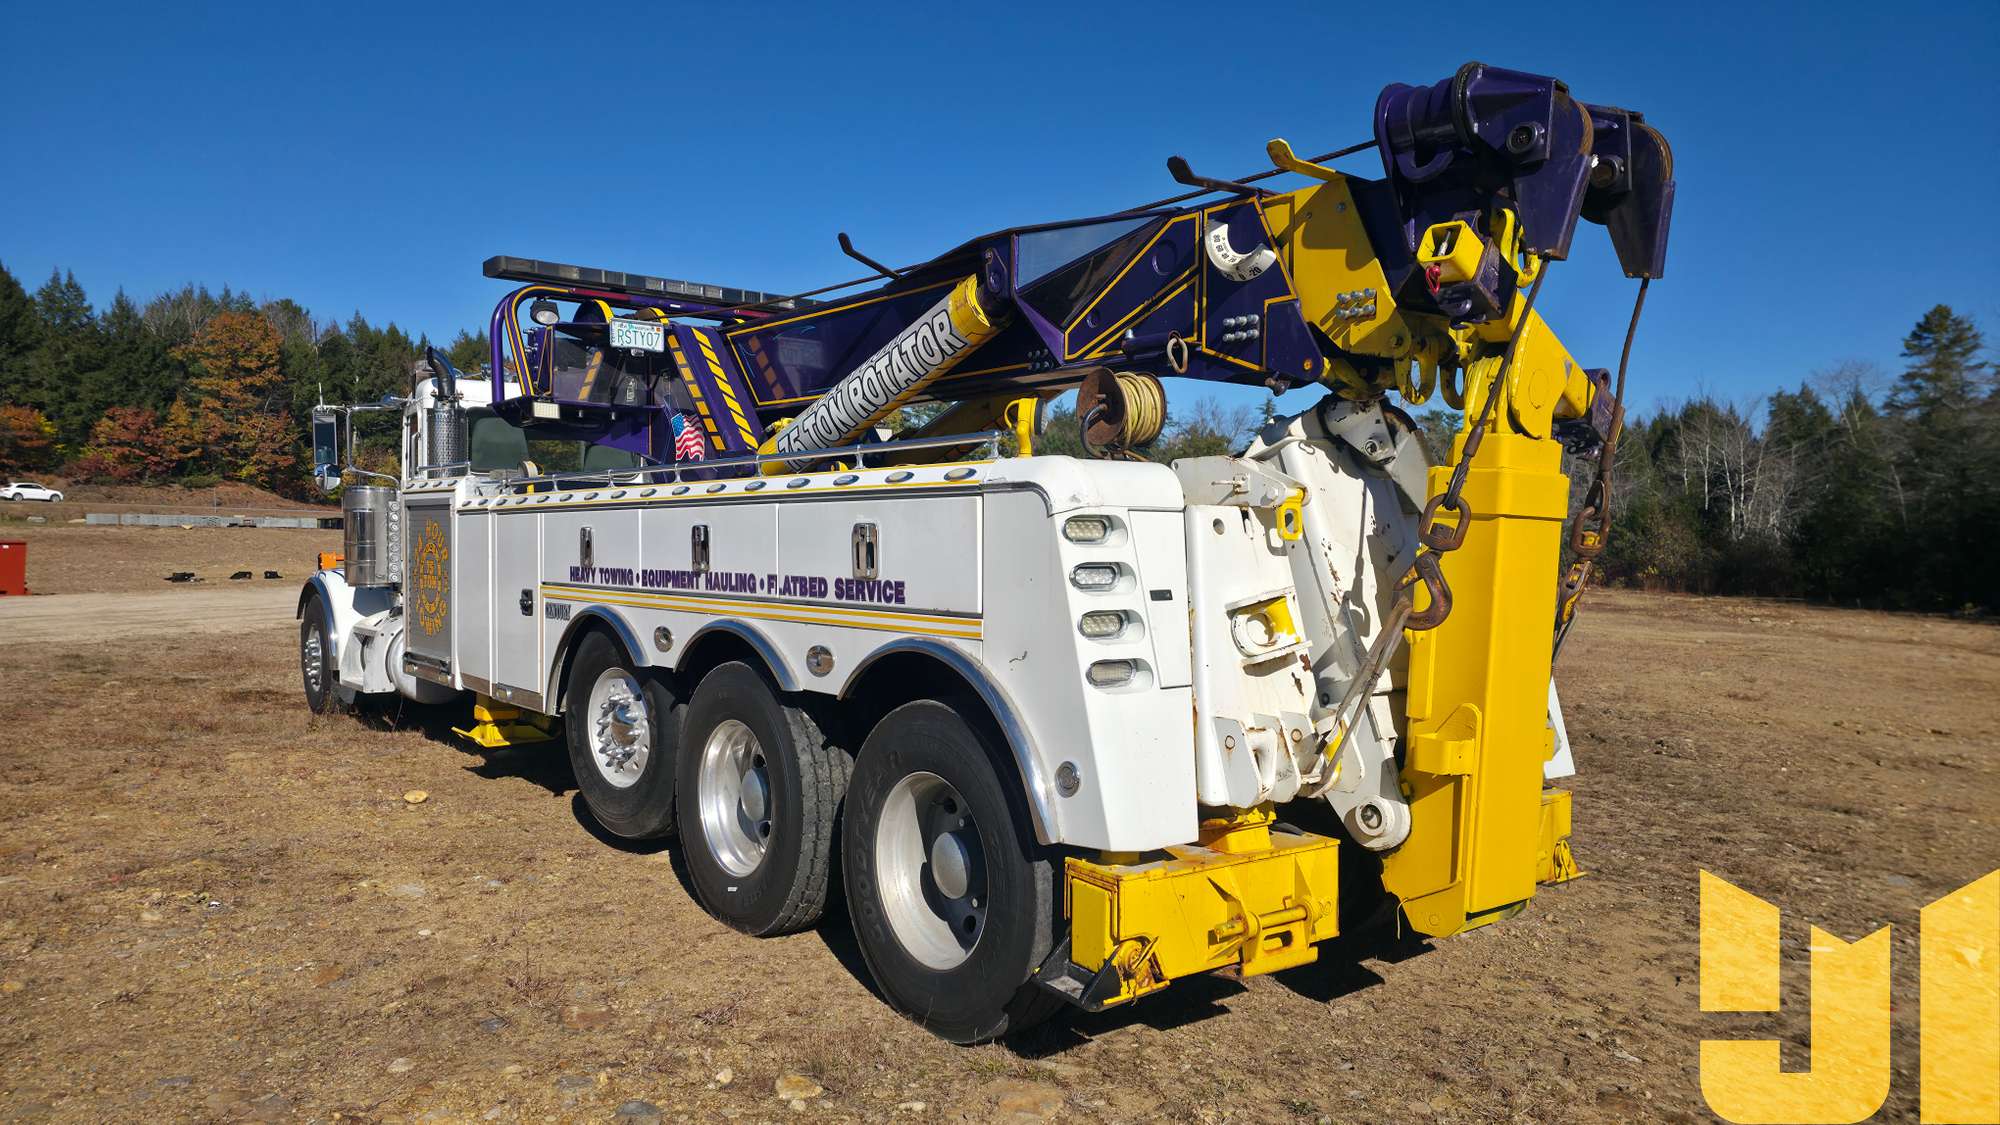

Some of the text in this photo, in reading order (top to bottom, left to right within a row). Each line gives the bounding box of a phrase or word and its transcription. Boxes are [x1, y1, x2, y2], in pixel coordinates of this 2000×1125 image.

[617, 328, 661, 347] RSTY07
[802, 386, 860, 449] TON
[847, 308, 968, 420] ROTATOR
[570, 565, 596, 583] HEAVY
[599, 567, 634, 586] TOWING
[641, 569, 701, 590] EQUIPMENT
[705, 572, 757, 594] HAULING
[834, 577, 906, 605] SERVICE
